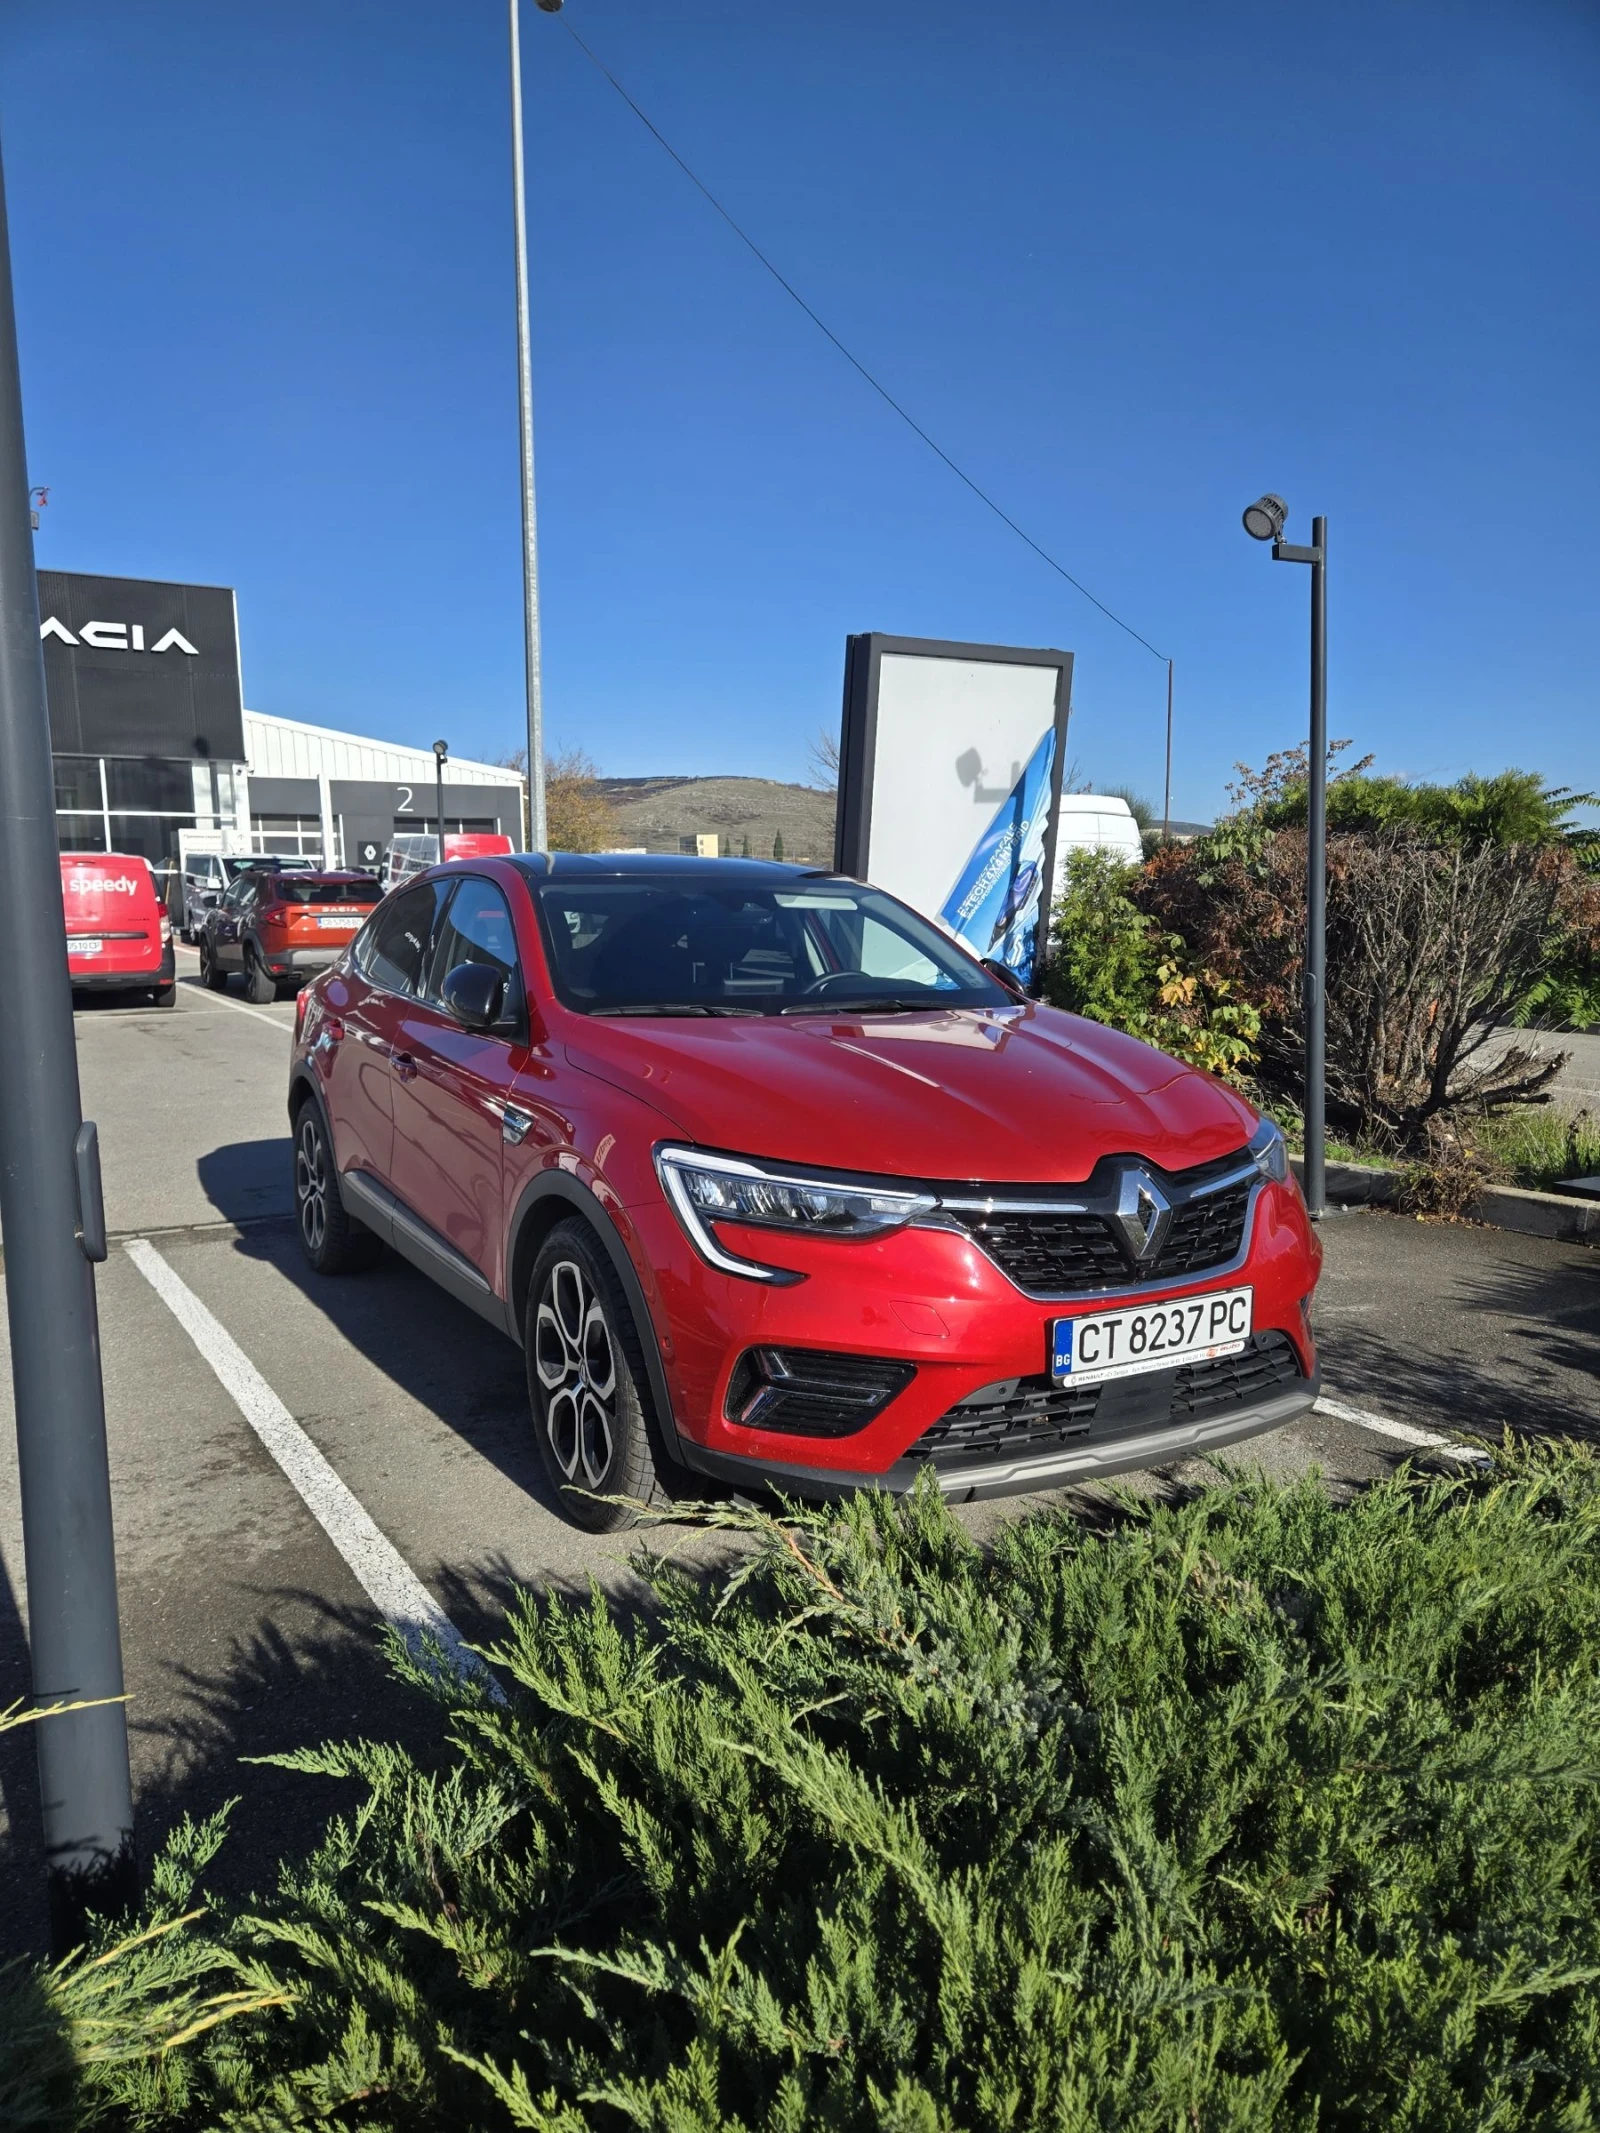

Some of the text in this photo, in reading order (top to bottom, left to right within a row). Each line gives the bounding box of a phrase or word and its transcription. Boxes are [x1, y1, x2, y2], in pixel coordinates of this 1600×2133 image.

[40, 616, 199, 655] ACIA
[396, 786, 414, 812] 2
[988, 821, 1018, 865] RAFALE
[70, 875, 137, 896] speedy
[959, 820, 1030, 918] E-TECH 4X4 HYBRID
[1079, 1320, 1122, 1363] CT
[1129, 1305, 1204, 1354] 8237
[1209, 1297, 1246, 1339] PC
[1056, 1356, 1071, 1367] BG
